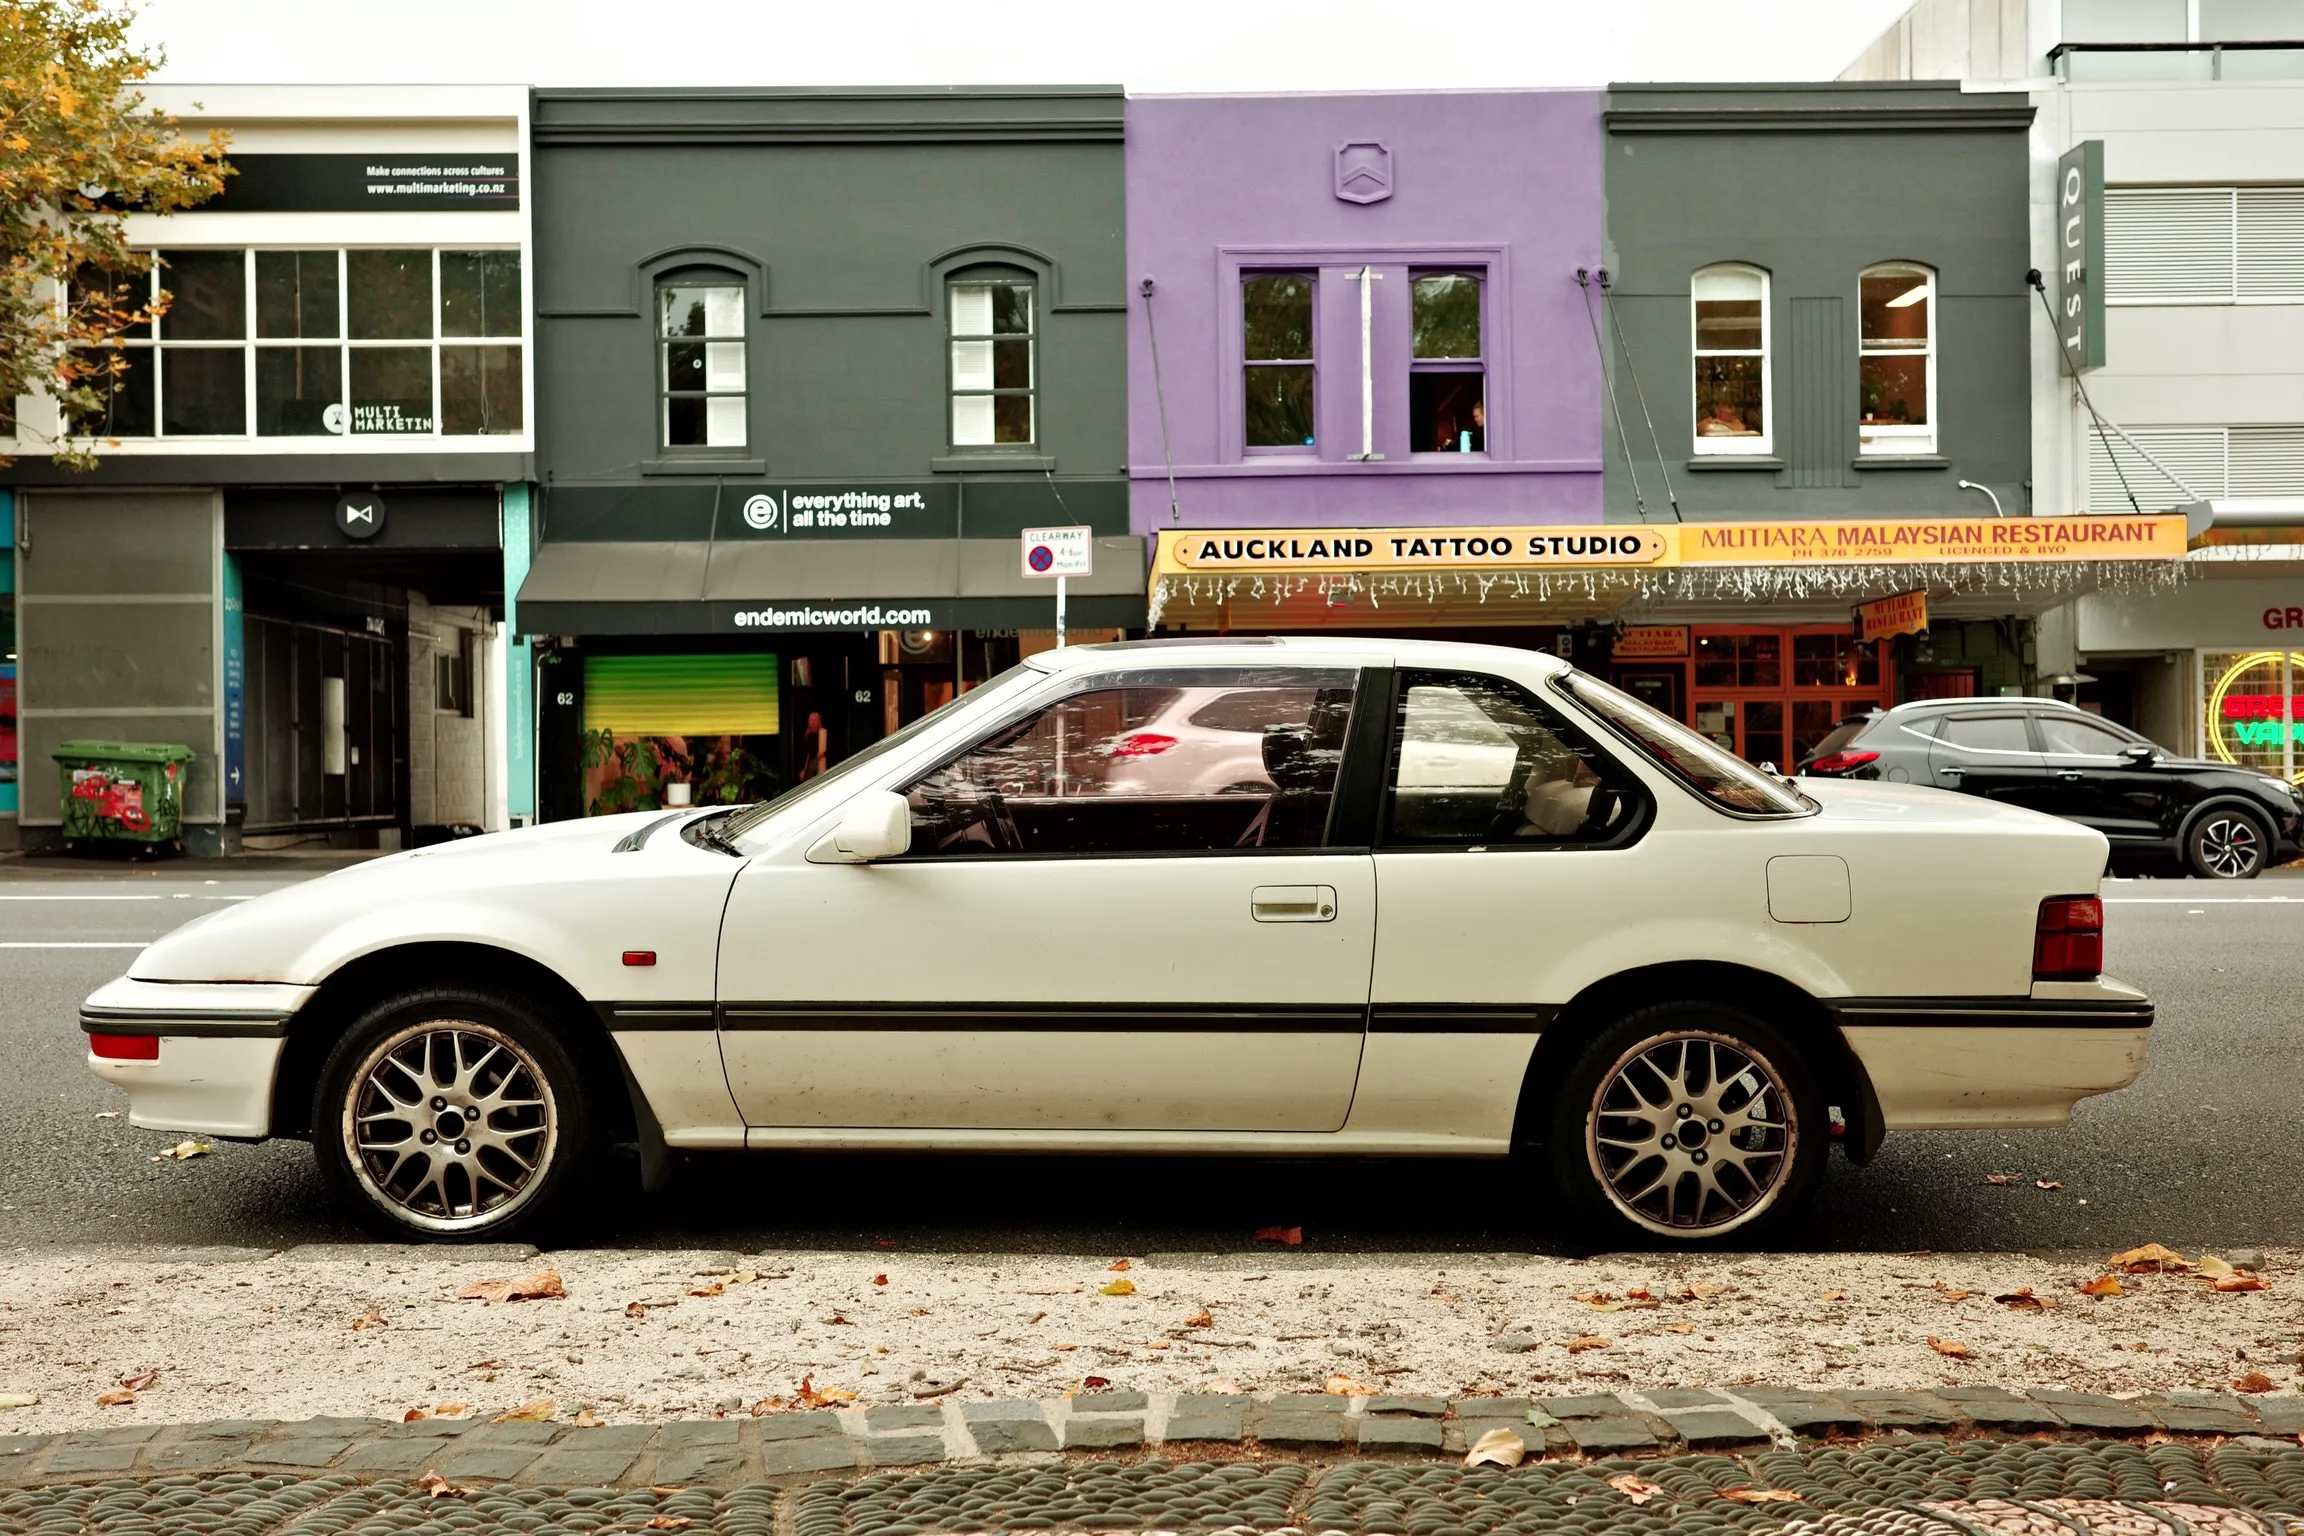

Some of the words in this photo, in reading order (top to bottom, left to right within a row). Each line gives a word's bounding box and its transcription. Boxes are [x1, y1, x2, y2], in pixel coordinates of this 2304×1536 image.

[366, 166, 389, 176] Make
[391, 166, 441, 176] connections
[443, 167, 469, 176] across
[471, 165, 505, 176] cultures
[367, 182, 505, 196] www.multimarketing.co.nz
[2063, 166, 2082, 351] QUEST
[354, 405, 400, 418] MULTI
[355, 417, 443, 431] MARKETIN
[792, 492, 890, 511] everything
[894, 492, 925, 509] art,
[792, 510, 813, 526] all
[817, 510, 847, 526] the
[849, 510, 891, 526] time
[1029, 531, 1084, 543] CLEARWAY
[1701, 527, 1828, 548] MUTIARA
[1837, 525, 1982, 545] MALAYSIAN
[1991, 522, 2157, 543] RESTAURANT
[1198, 538, 1374, 560] AUCKLAND
[1390, 536, 1513, 558] TATTOO
[1528, 535, 1641, 556] STUDIO
[1792, 548, 1813, 558] PH
[1820, 547, 1847, 557] 376
[1854, 547, 1892, 557] 2759
[1939, 546, 2013, 556] LICENCED
[2019, 546, 2030, 555] &
[2038, 545, 2066, 554] BYO
[1874, 595, 1915, 615] MUTIARA
[734, 606, 931, 627] endemicworld.com
[557, 692, 574, 705] 62
[855, 690, 871, 703] 62
